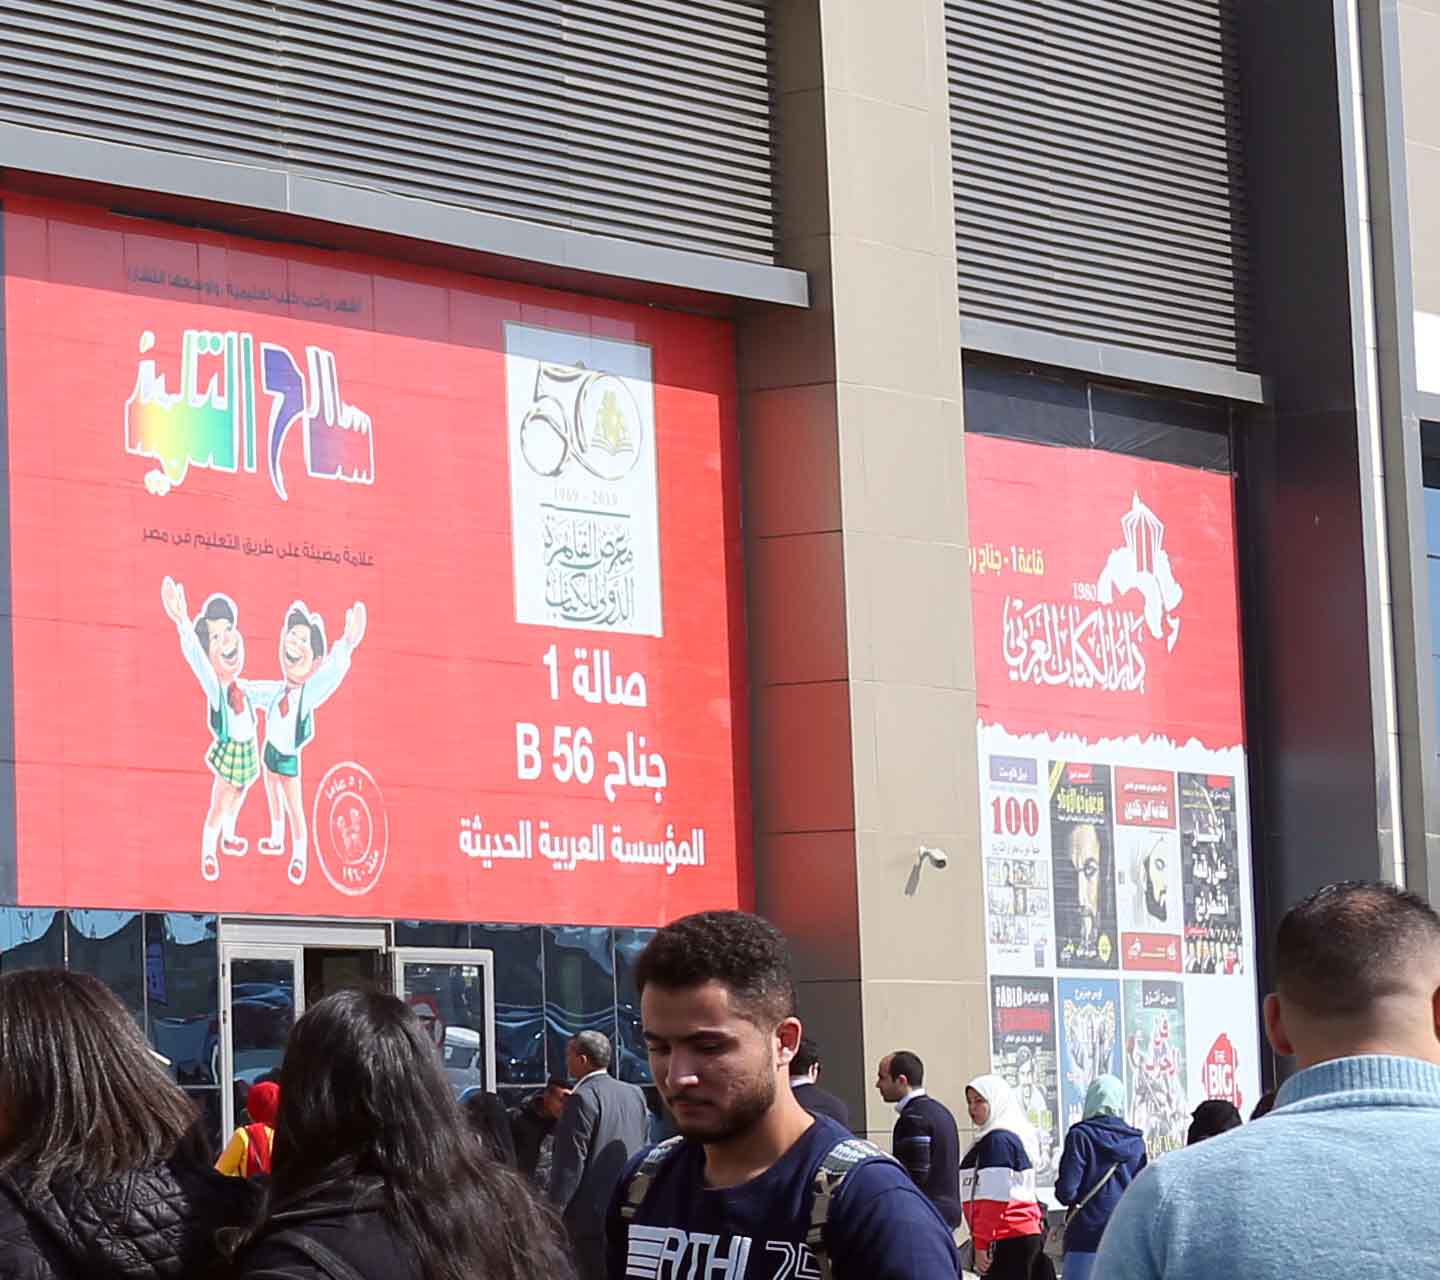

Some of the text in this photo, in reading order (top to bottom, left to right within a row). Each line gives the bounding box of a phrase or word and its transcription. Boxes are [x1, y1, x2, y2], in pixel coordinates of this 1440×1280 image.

[543, 644, 647, 707] صالة 1
[516, 722, 667, 803] جناح B 56
[991, 796, 1039, 837] 100
[459, 815, 705, 875] المؤسسة العربية الحديثة
[995, 985, 1022, 1008] PABLO
[1208, 1063, 1233, 1095] BIG
